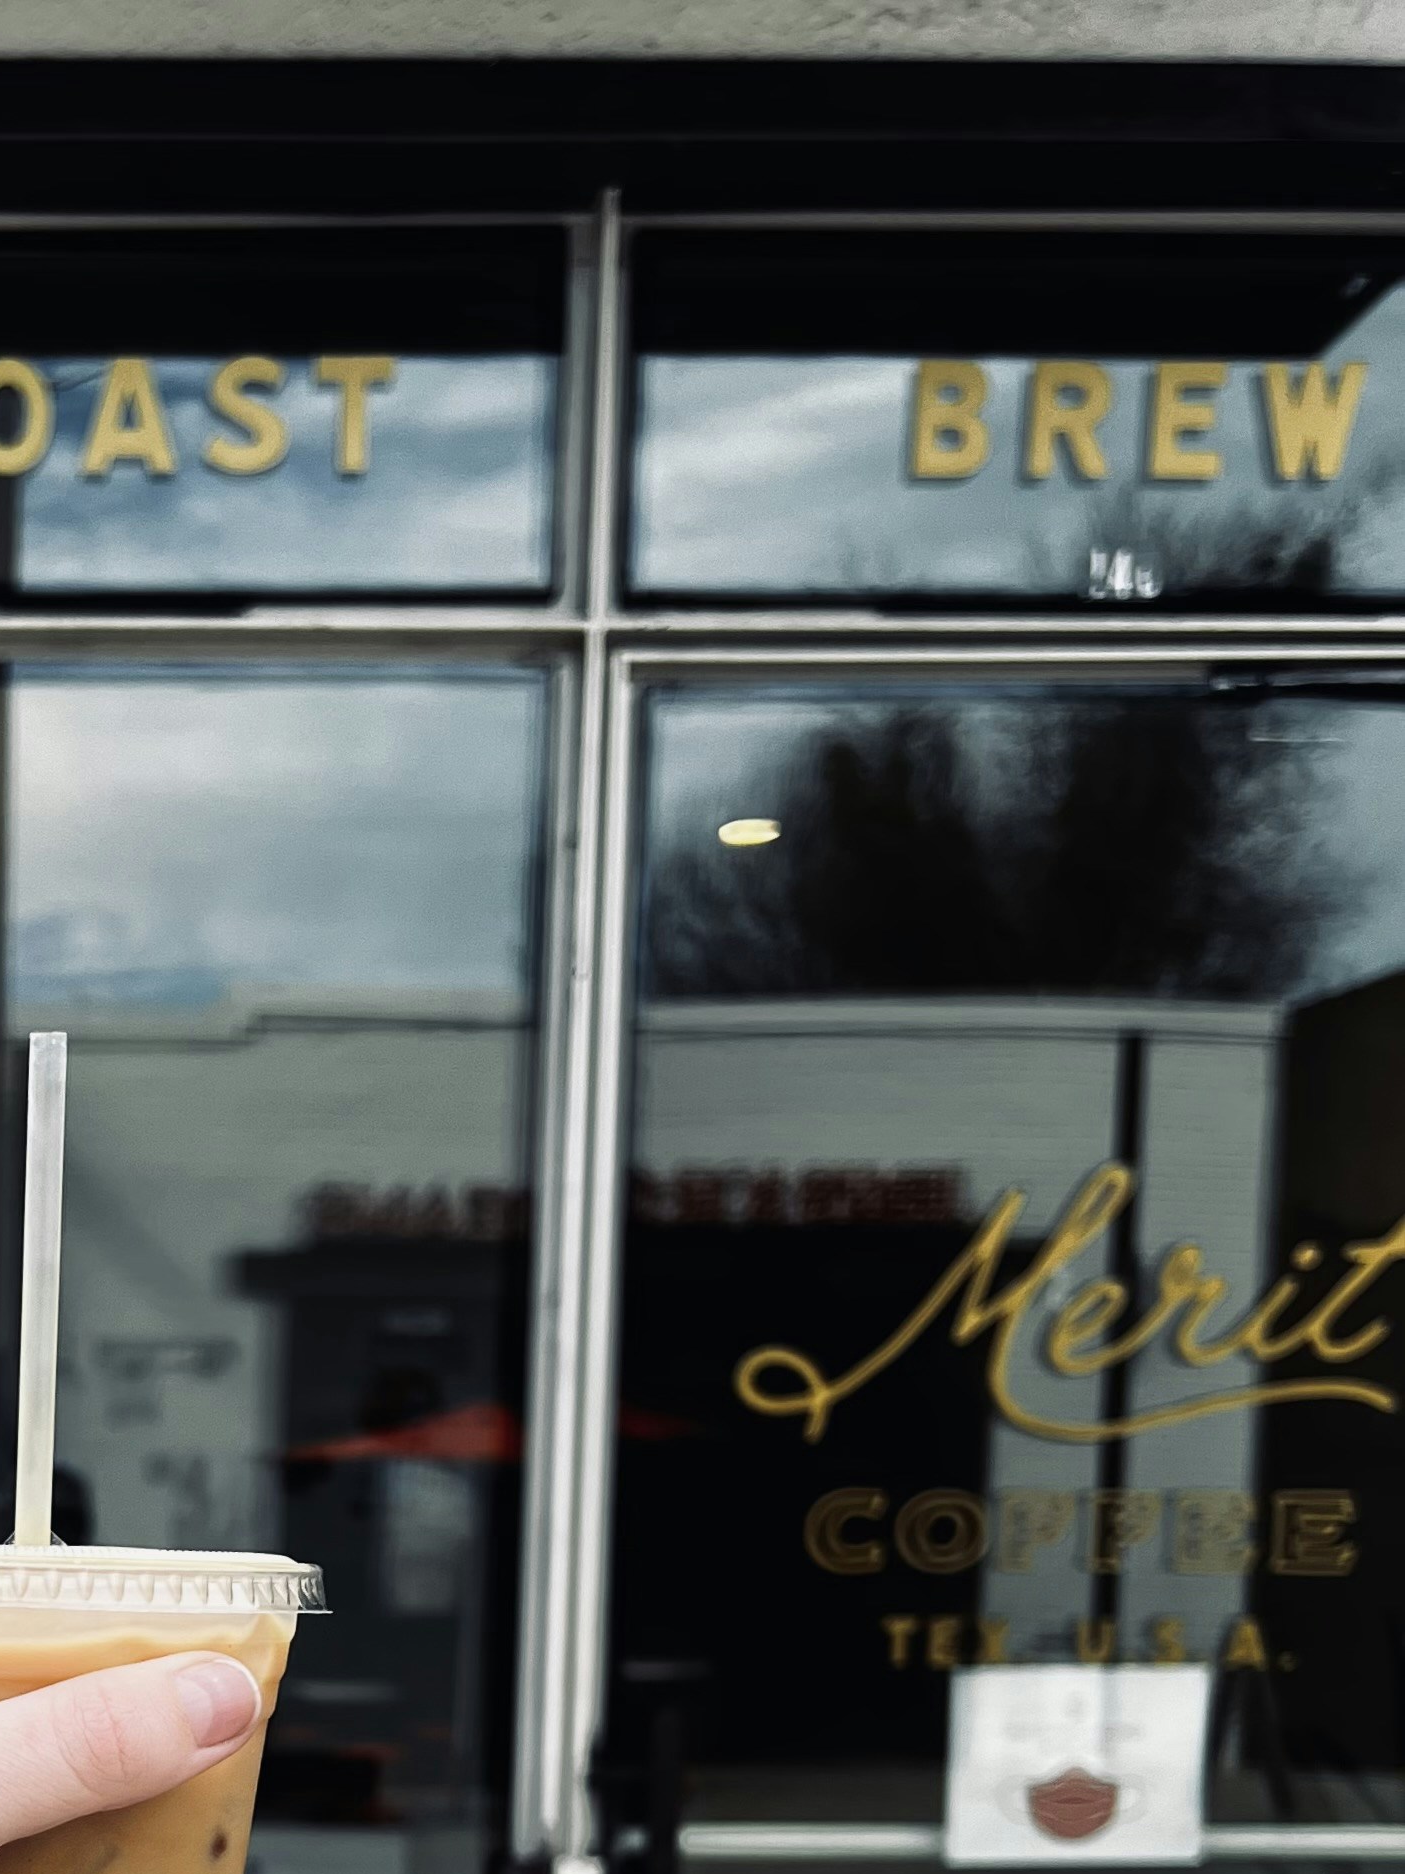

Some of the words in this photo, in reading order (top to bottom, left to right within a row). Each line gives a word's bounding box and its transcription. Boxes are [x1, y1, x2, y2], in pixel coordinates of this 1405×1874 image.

[910, 358, 1370, 482] BREW
[733, 1162, 1405, 1446] Merit
[804, 1487, 1361, 1576] COFFEE
